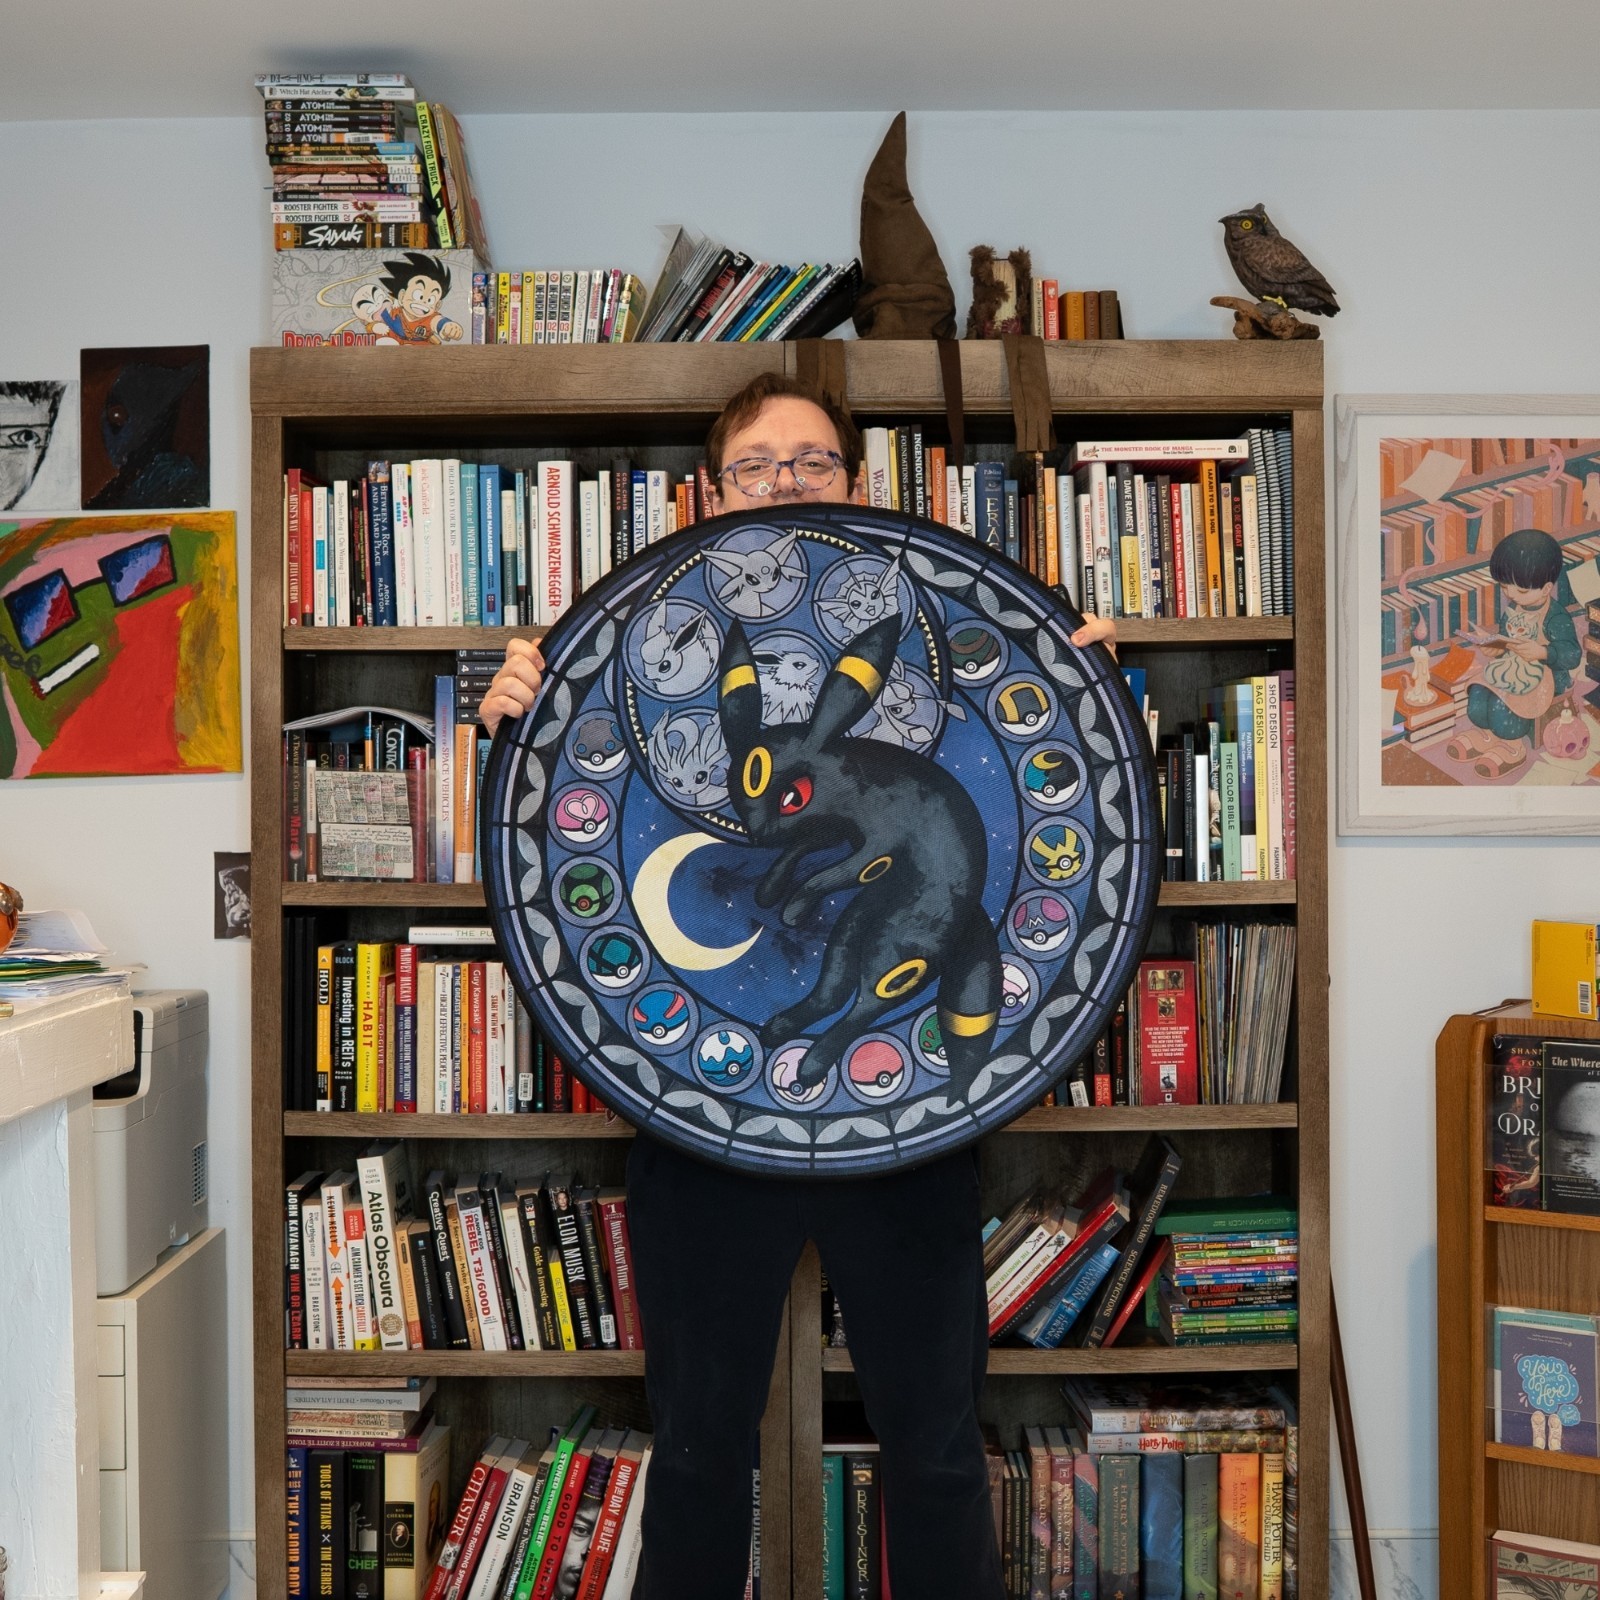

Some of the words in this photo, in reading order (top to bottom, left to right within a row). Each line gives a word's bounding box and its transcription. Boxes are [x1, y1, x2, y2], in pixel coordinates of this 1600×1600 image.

[419, 114, 429, 139] CRAZY
[424, 141, 434, 160] FOOD
[428, 162, 439, 186] TRUCK
[466, 486, 474, 513] Essentials
[547, 467, 561, 508] ARNOLD
[1124, 480, 1132, 497] DAVE
[1124, 500, 1133, 533] RAMSEY
[1234, 505, 1240, 513] TO
[467, 526, 475, 565] INVENTORY
[548, 512, 561, 606] SCHWARZENEGGER
[468, 568, 477, 615] MANAGEMENT
[1256, 709, 1264, 744] DESIGN
[1270, 718, 1278, 749] DESIGN
[1226, 773, 1234, 802] COLOR
[291, 816, 302, 850] Mars
[1227, 806, 1235, 830] BIBLE
[399, 947, 411, 972] HARVEY
[320, 970, 329, 1004] HOLD
[400, 977, 411, 1002] MACKAY
[472, 970, 480, 985] Guy
[340, 977, 354, 1023] Investing
[439, 994, 447, 1017] HIGHLY
[473, 987, 481, 1024] Kawasaki
[342, 1027, 353, 1036] in
[363, 1001, 372, 1048] HABIT
[342, 1040, 354, 1067] REITs
[475, 1041, 483, 1093] Enchantment
[1552, 1057, 1568, 1066] The
[289, 1192, 298, 1216] JOHN
[368, 1191, 384, 1232] Atlas
[1146, 1184, 1167, 1222] REMEDIOS
[431, 1192, 444, 1230] Creative
[438, 1233, 449, 1260] Quest
[557, 1215, 578, 1245] ELON
[1137, 1222, 1150, 1243] VARO
[289, 1220, 299, 1269] KAVANAGH
[534, 1246, 544, 1266] Guide
[375, 1236, 394, 1308] Obscura
[464, 1215, 477, 1255] REBEL
[473, 1258, 490, 1316] T3i/600D
[564, 1248, 585, 1282] MUSK
[1122, 1249, 1137, 1282] SCIENCE
[291, 1274, 299, 1292] WIN
[445, 1272, 454, 1299] Questlove
[538, 1276, 550, 1307] Investing
[291, 1295, 300, 1307] OR
[1104, 1280, 1124, 1317] FICTIONS
[292, 1310, 301, 1339] LEARN
[1524, 1360, 1562, 1390] You
[1535, 1374, 1571, 1406] Here
[1138, 1440, 1160, 1449] Harry
[1162, 1440, 1185, 1449] Potter
[320, 1464, 331, 1488] TOOLS
[552, 1452, 567, 1489] STONED
[288, 1495, 299, 1515] THE
[320, 1491, 331, 1499] OF
[451, 1467, 485, 1536] CHASER
[545, 1490, 555, 1514] BEYOND
[1272, 1482, 1282, 1527] HARRY
[320, 1502, 331, 1530] TITANS
[479, 1501, 491, 1522] BRUCE
[497, 1482, 524, 1540] BRANSON
[556, 1493, 572, 1528] GOOD
[474, 1523, 485, 1536] LEE:
[536, 1515, 549, 1547] BELIEF
[550, 1536, 561, 1551] TO
[857, 1490, 868, 1581] BRISINGR
[321, 1547, 331, 1560] TIM
[461, 1537, 481, 1568] FIGHTING
[1272, 1530, 1282, 1565] POTTER
[321, 1563, 331, 1595] FERRISS
[348, 1559, 378, 1570] CHEF
[289, 1566, 300, 1595] BODY
